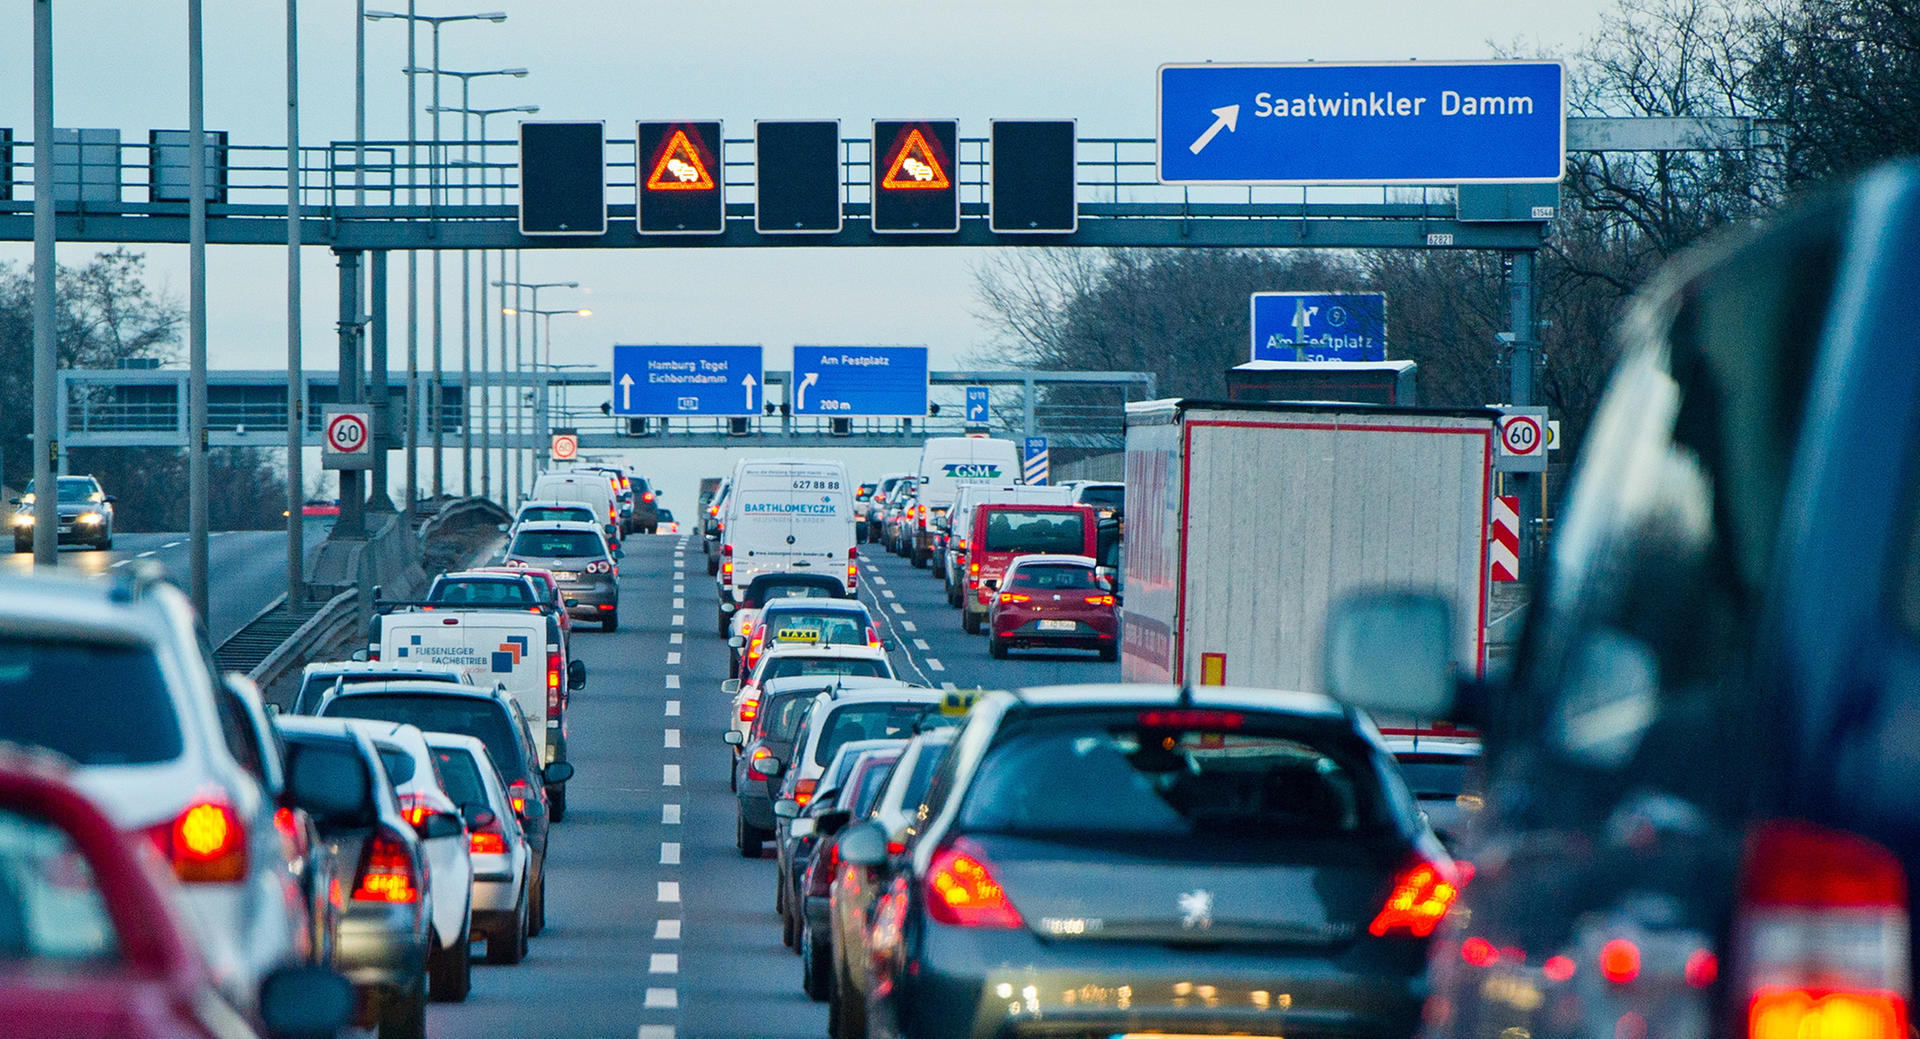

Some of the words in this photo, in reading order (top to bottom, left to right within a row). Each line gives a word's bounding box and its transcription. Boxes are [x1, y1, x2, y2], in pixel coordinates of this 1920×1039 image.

[1254, 92, 1426, 117] Saatwinkler
[1441, 91, 1534, 116] Damm
[648, 360, 696, 372] Hamburg
[700, 360, 728, 372] Tegel
[821, 355, 839, 365] Am
[842, 355, 890, 367] Festplatz
[649, 373, 728, 384] Eichborndamm
[820, 400, 839, 410] 200
[840, 402, 850, 410] m
[337, 425, 359, 442] 60
[1511, 427, 1532, 444] 60
[955, 466, 990, 478] GSM
[793, 481, 811, 489] 627
[813, 481, 825, 490] 88
[828, 482, 840, 490] 88
[744, 503, 836, 513] BARTHLOMEYCZIK
[415, 647, 475, 656] FLIESENLEGER
[431, 656, 488, 666] FACHBETRIEB
